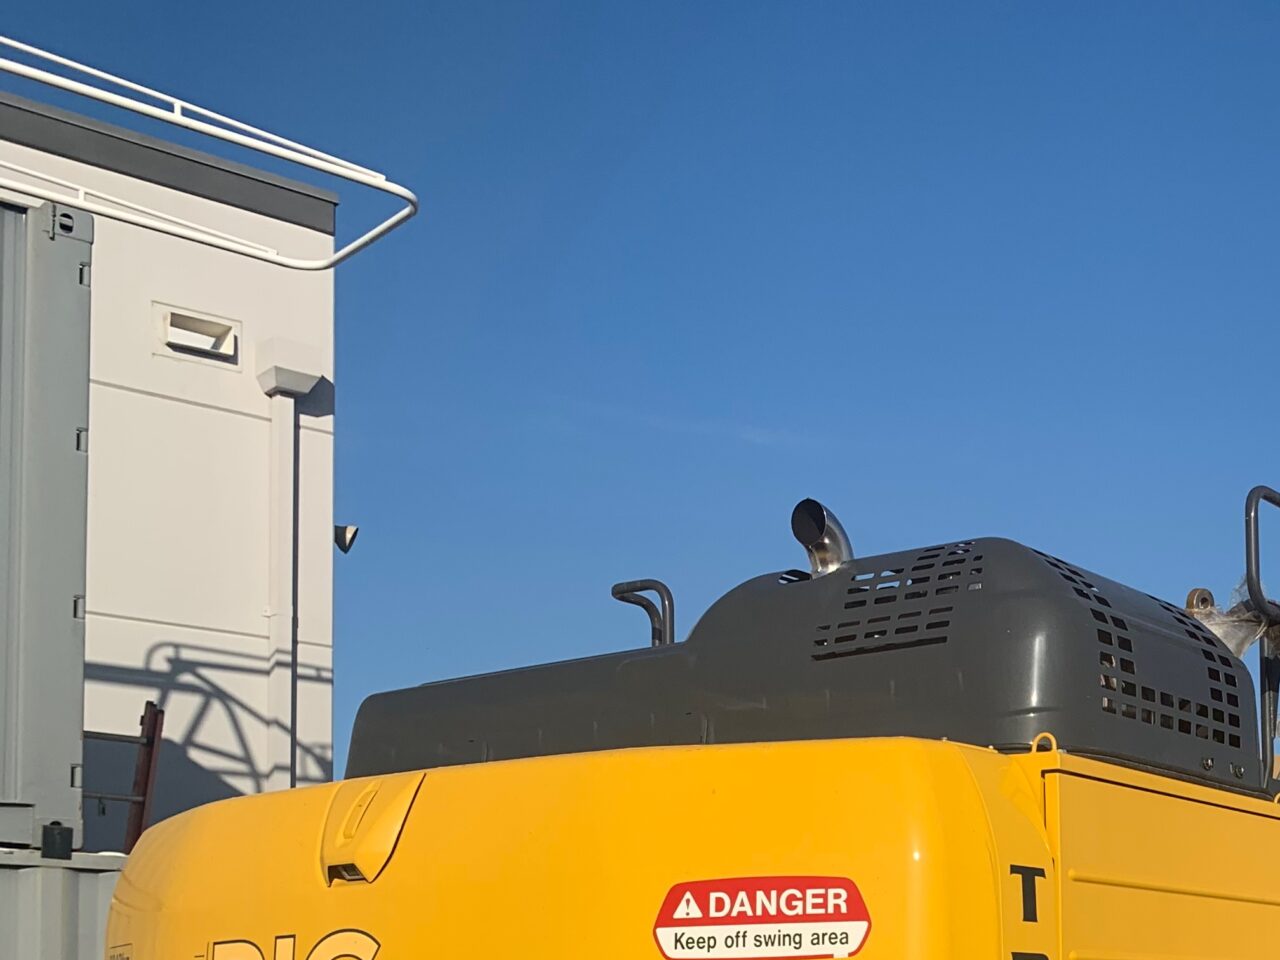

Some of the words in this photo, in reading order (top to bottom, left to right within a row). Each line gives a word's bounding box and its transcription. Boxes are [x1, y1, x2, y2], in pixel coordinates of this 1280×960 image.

[708, 888, 848, 918] DANGER
[673, 931, 717, 952] Keep
[724, 930, 748, 949] off
[753, 929, 803, 949] swing
[810, 931, 849, 946] area
